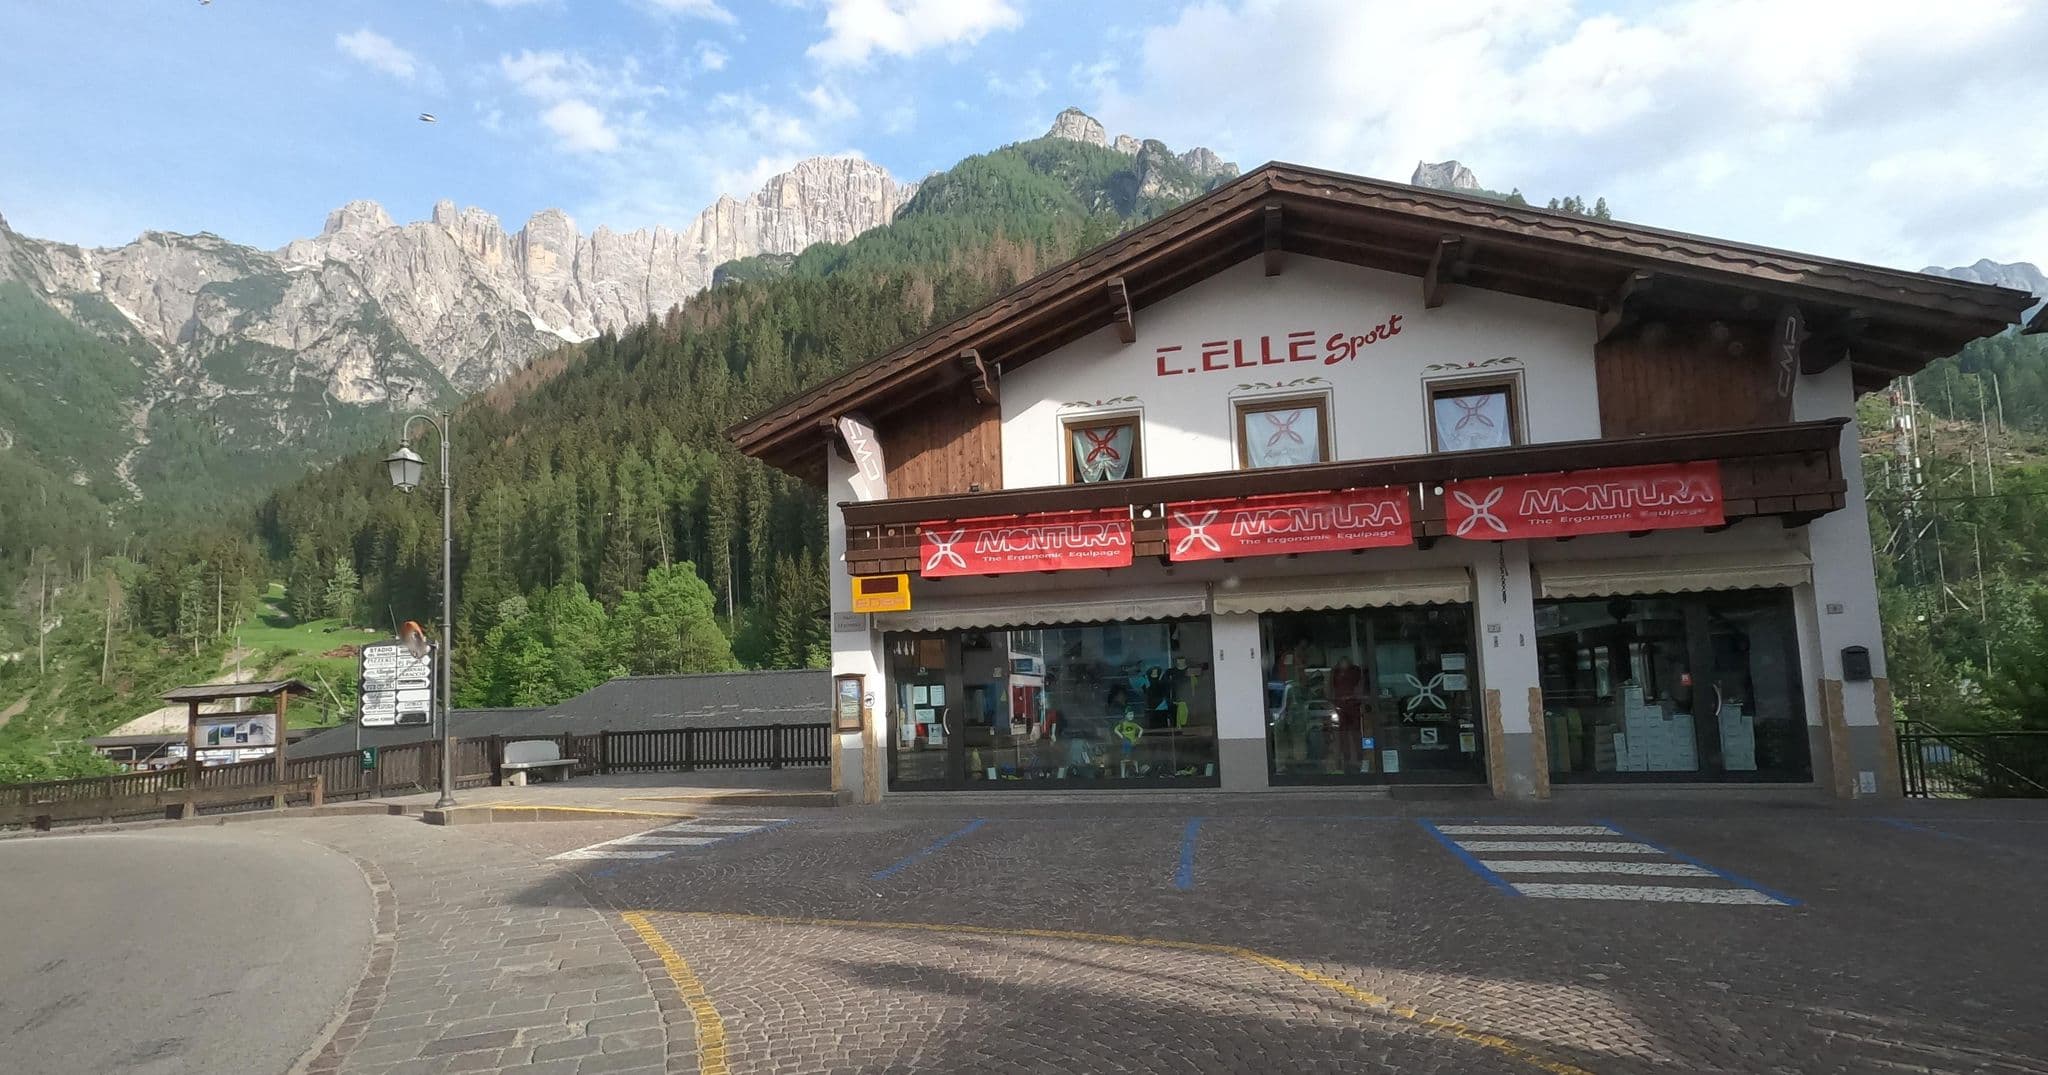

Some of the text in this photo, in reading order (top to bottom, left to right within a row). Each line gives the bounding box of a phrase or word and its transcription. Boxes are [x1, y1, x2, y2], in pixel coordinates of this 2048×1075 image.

[1323, 314, 1403, 365] Sport
[1519, 479, 1714, 516] MONTURA
[1230, 501, 1402, 537] MONTURA
[1560, 512, 1632, 524] Ergonomic
[974, 523, 1126, 553] MONTURA
[1267, 534, 1329, 545] Ergonomic
[1337, 529, 1396, 540] Equipage
[1007, 552, 1063, 561] Ergonomic
[1069, 549, 1121, 558] Equipage
